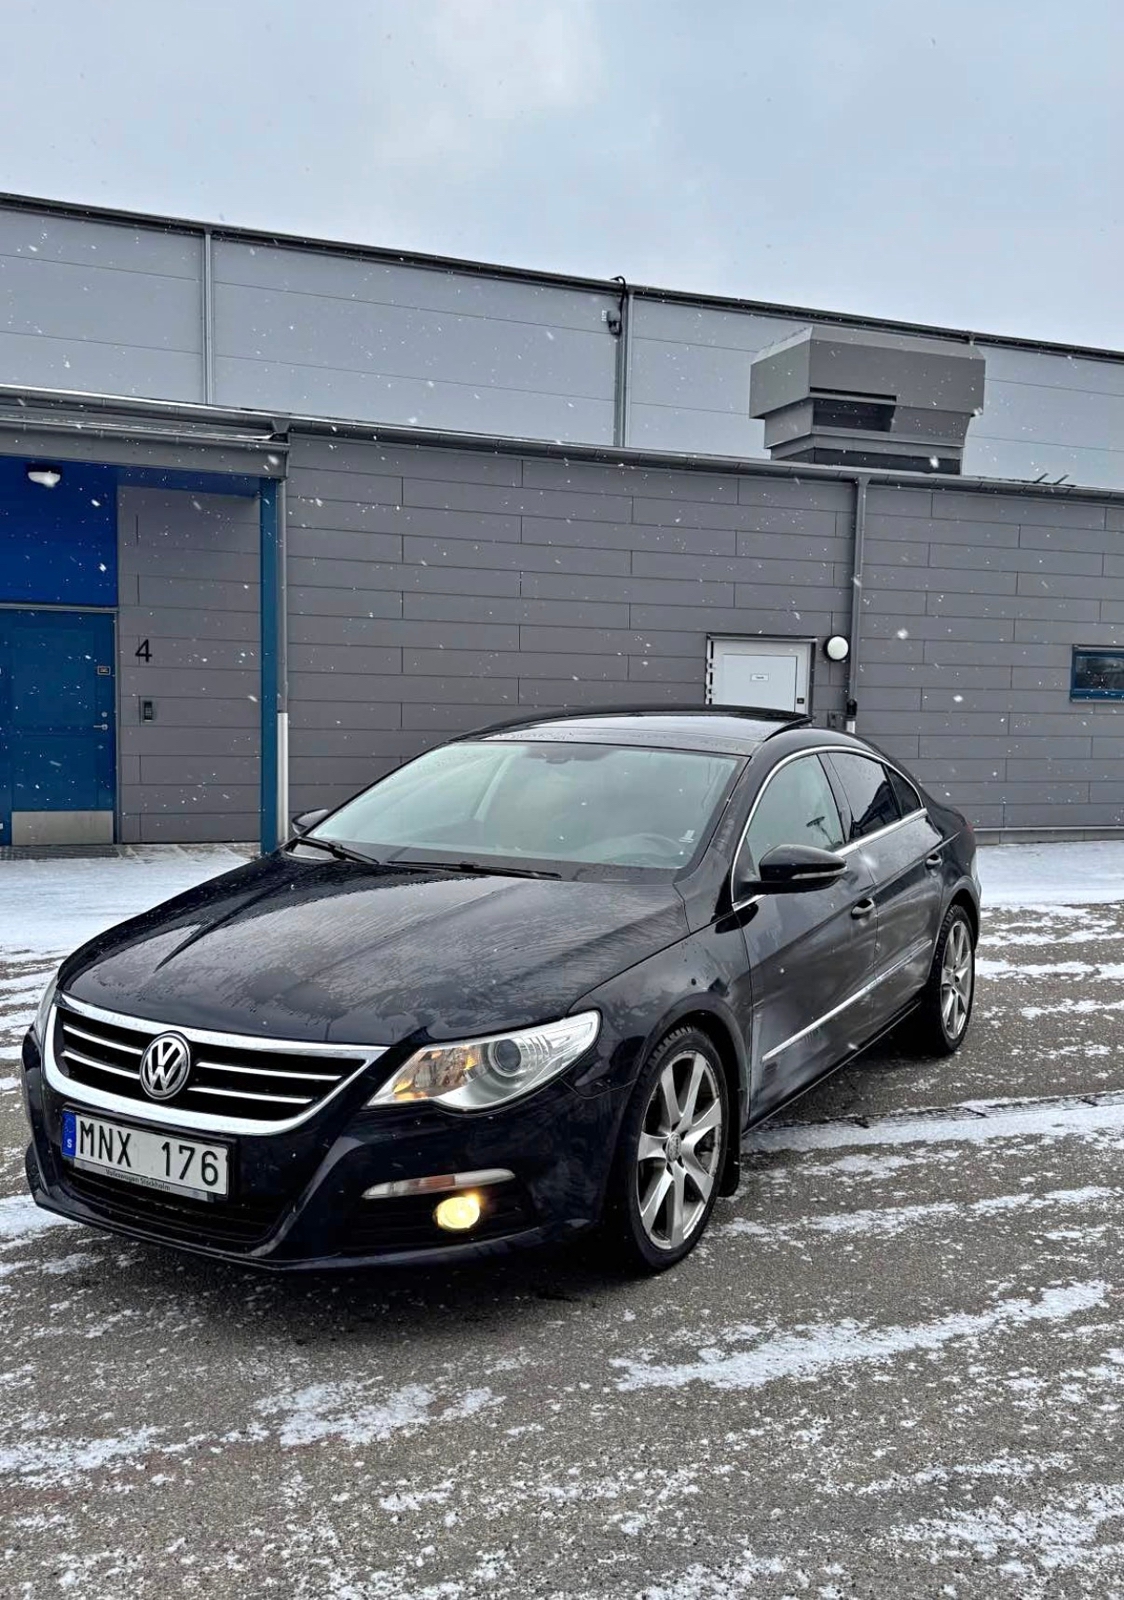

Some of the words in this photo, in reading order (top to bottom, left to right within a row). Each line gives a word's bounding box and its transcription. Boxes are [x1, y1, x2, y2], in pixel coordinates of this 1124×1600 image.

[135, 638, 153, 662] 4
[66, 1138, 73, 1148] S
[80, 1120, 132, 1168] MNX
[161, 1141, 219, 1187] 176
[140, 1177, 171, 1191] Stockholm
